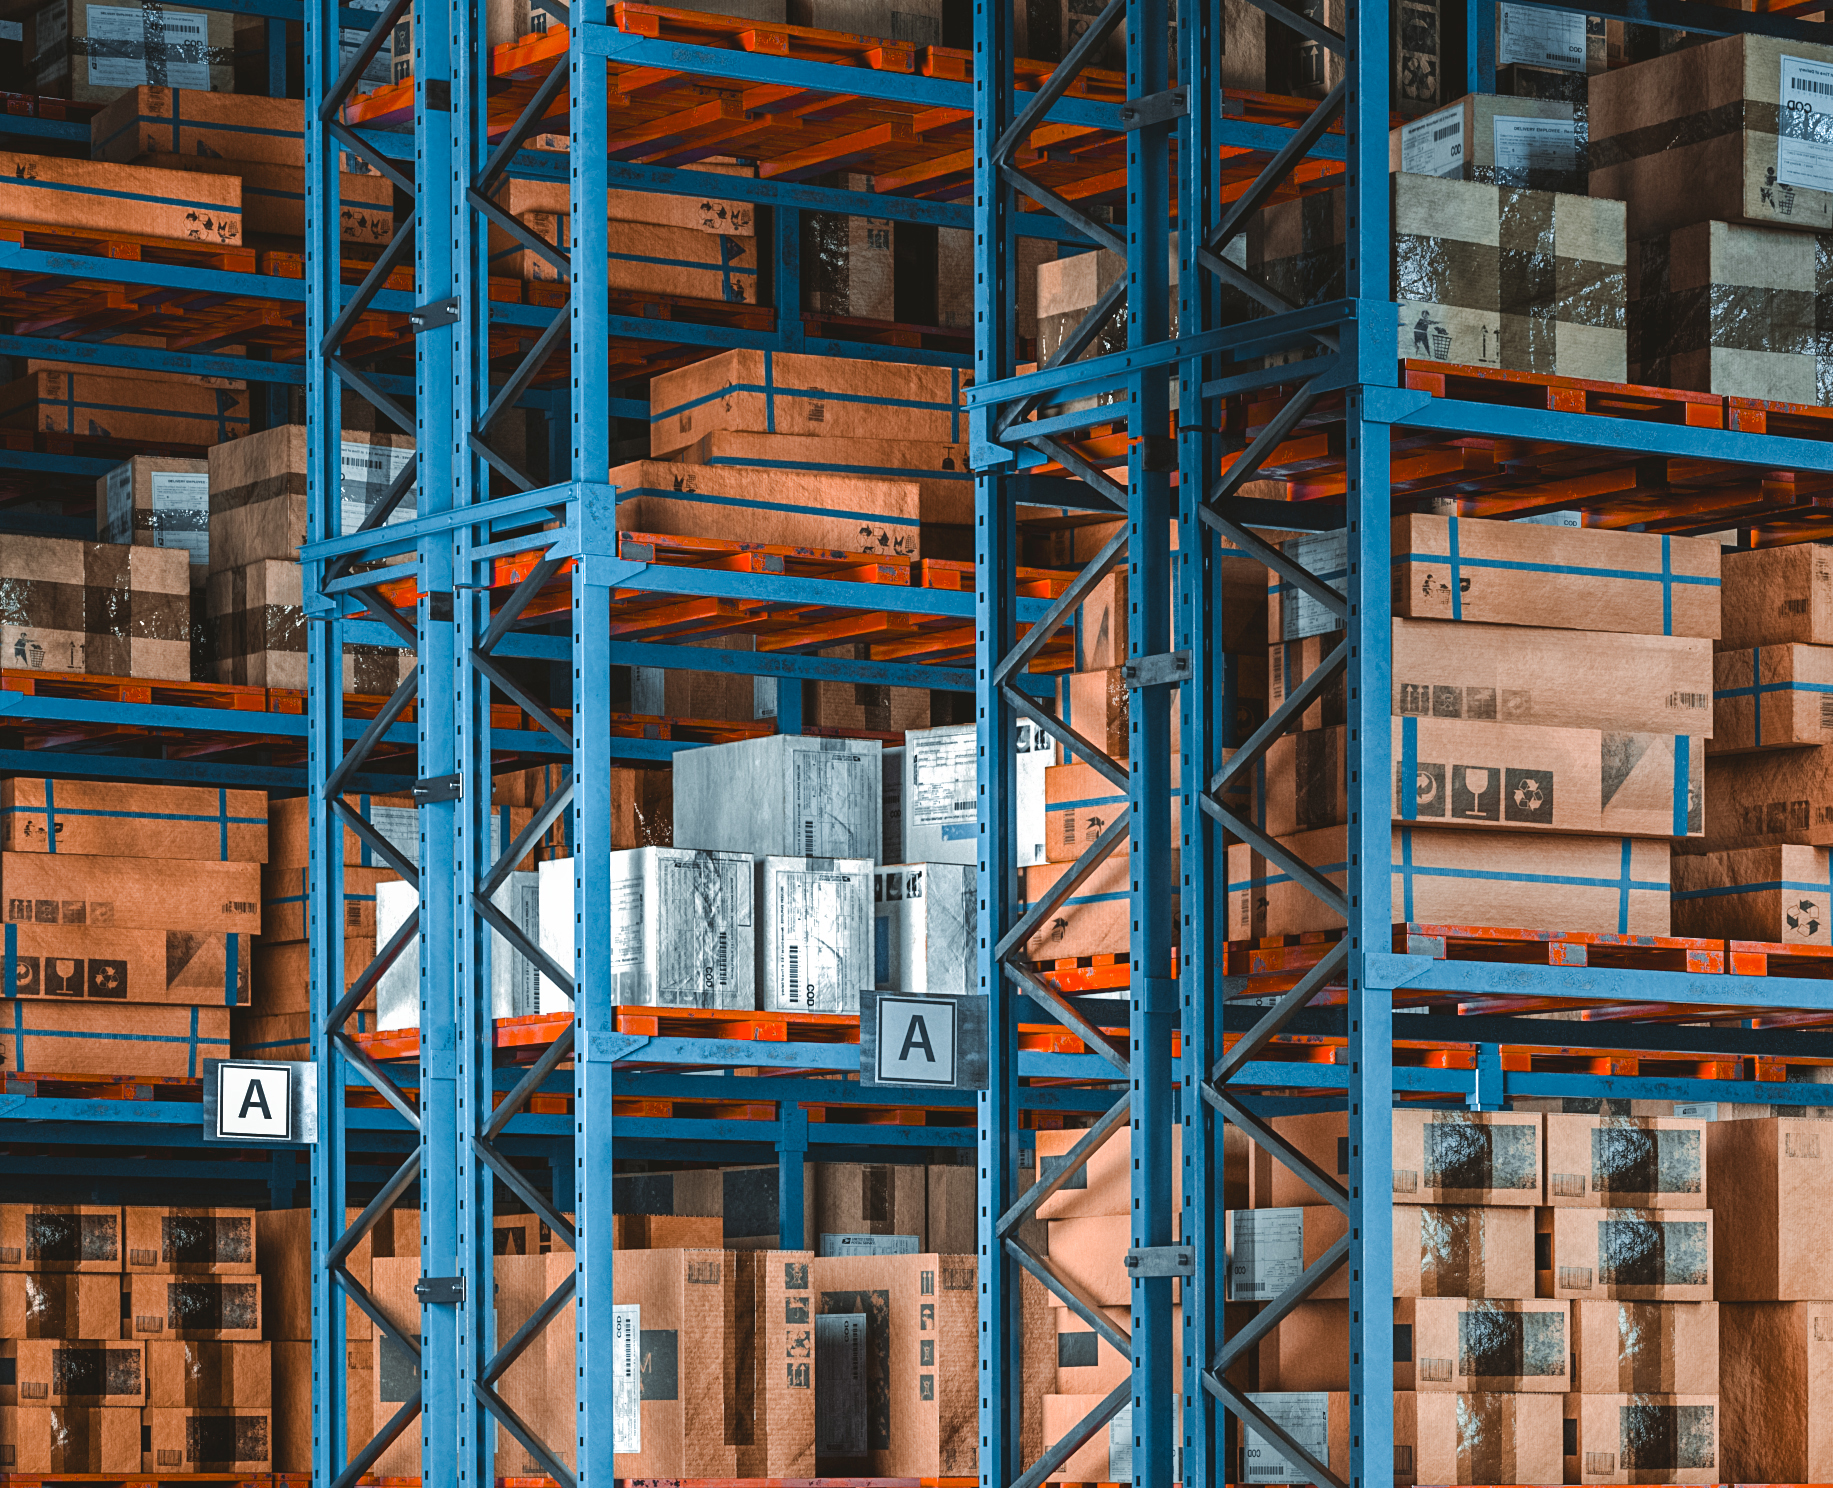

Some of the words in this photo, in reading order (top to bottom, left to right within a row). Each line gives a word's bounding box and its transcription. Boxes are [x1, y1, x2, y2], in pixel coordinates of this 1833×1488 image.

[184, 39, 203, 48] COD
[704, 966, 713, 988] COD
[806, 984, 815, 1007] COD
[898, 1015, 936, 1063] A
[238, 1079, 272, 1119] A
[1248, 1449, 1261, 1457] COD
